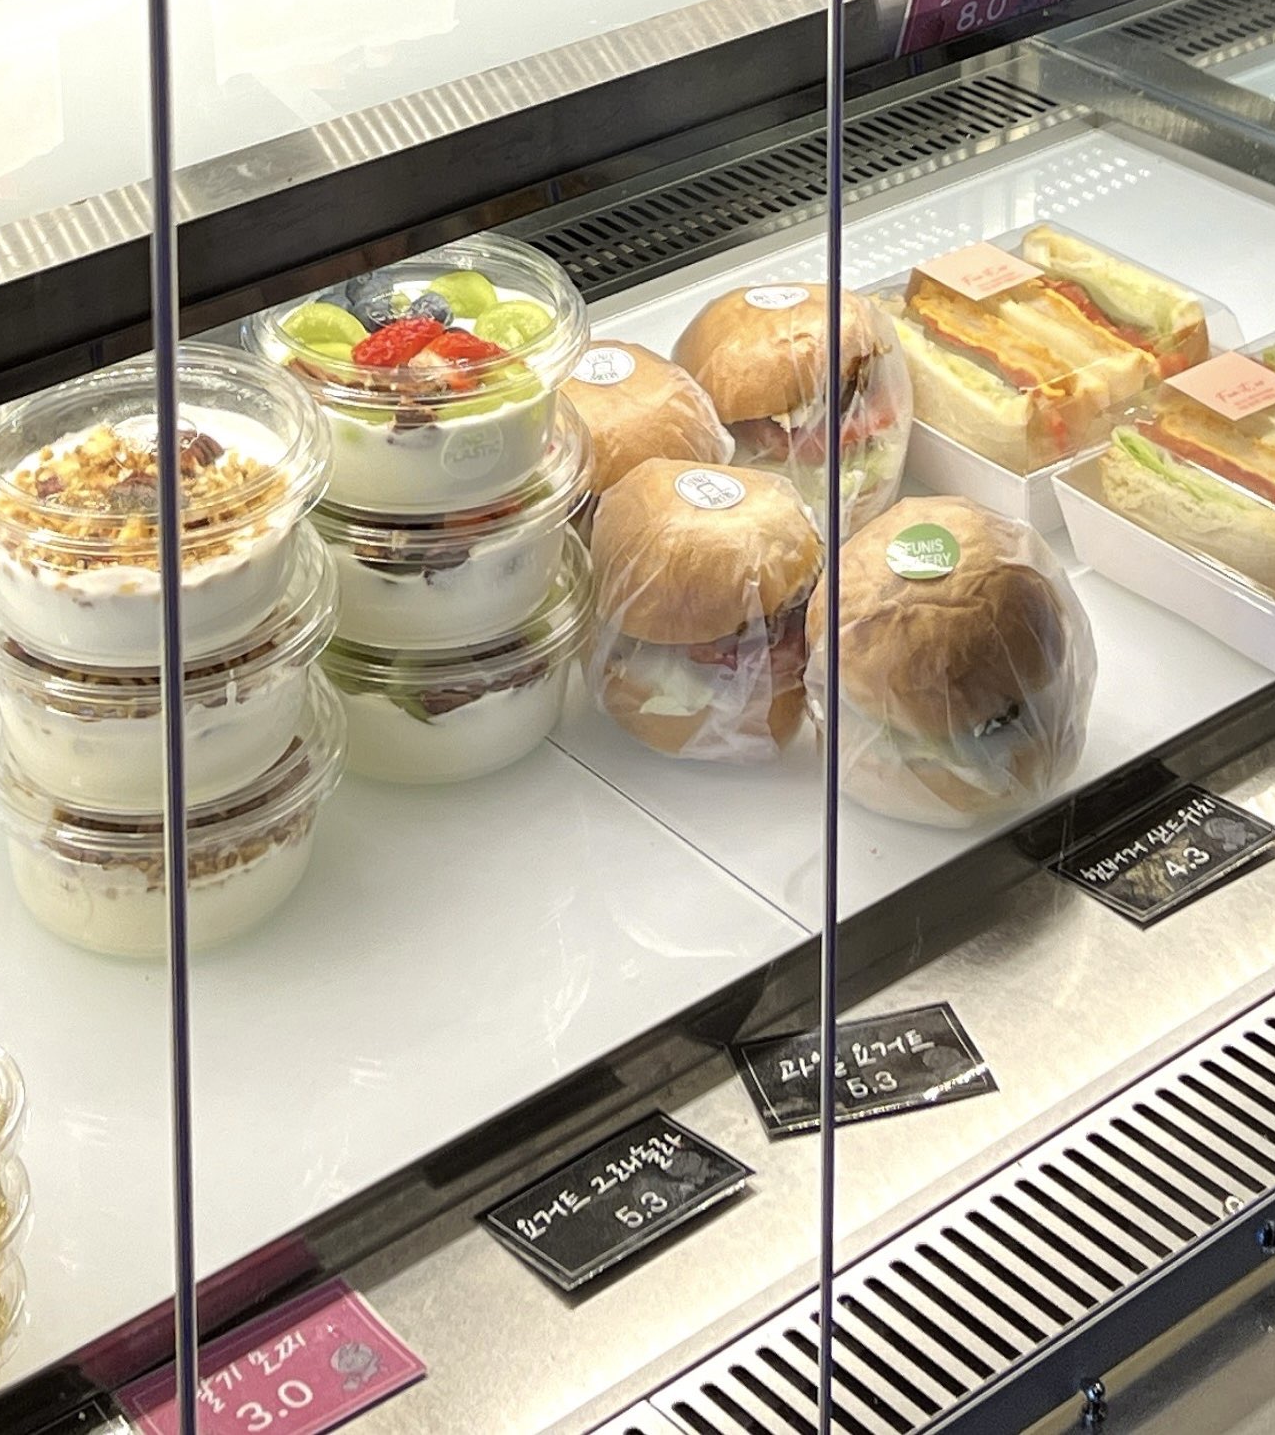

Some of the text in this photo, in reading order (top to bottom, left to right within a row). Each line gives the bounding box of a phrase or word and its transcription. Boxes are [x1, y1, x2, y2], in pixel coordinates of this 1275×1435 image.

[1146, 799, 1216, 844] 샌드위치
[1165, 847, 1210, 877] 4.3
[852, 1029, 935, 1066] 요거트
[846, 1070, 898, 1099] 5.3
[516, 1132, 683, 1241] 요거트 그래놀라
[615, 1191, 668, 1228] 5.3
[236, 1379, 313, 1432] 3.0
